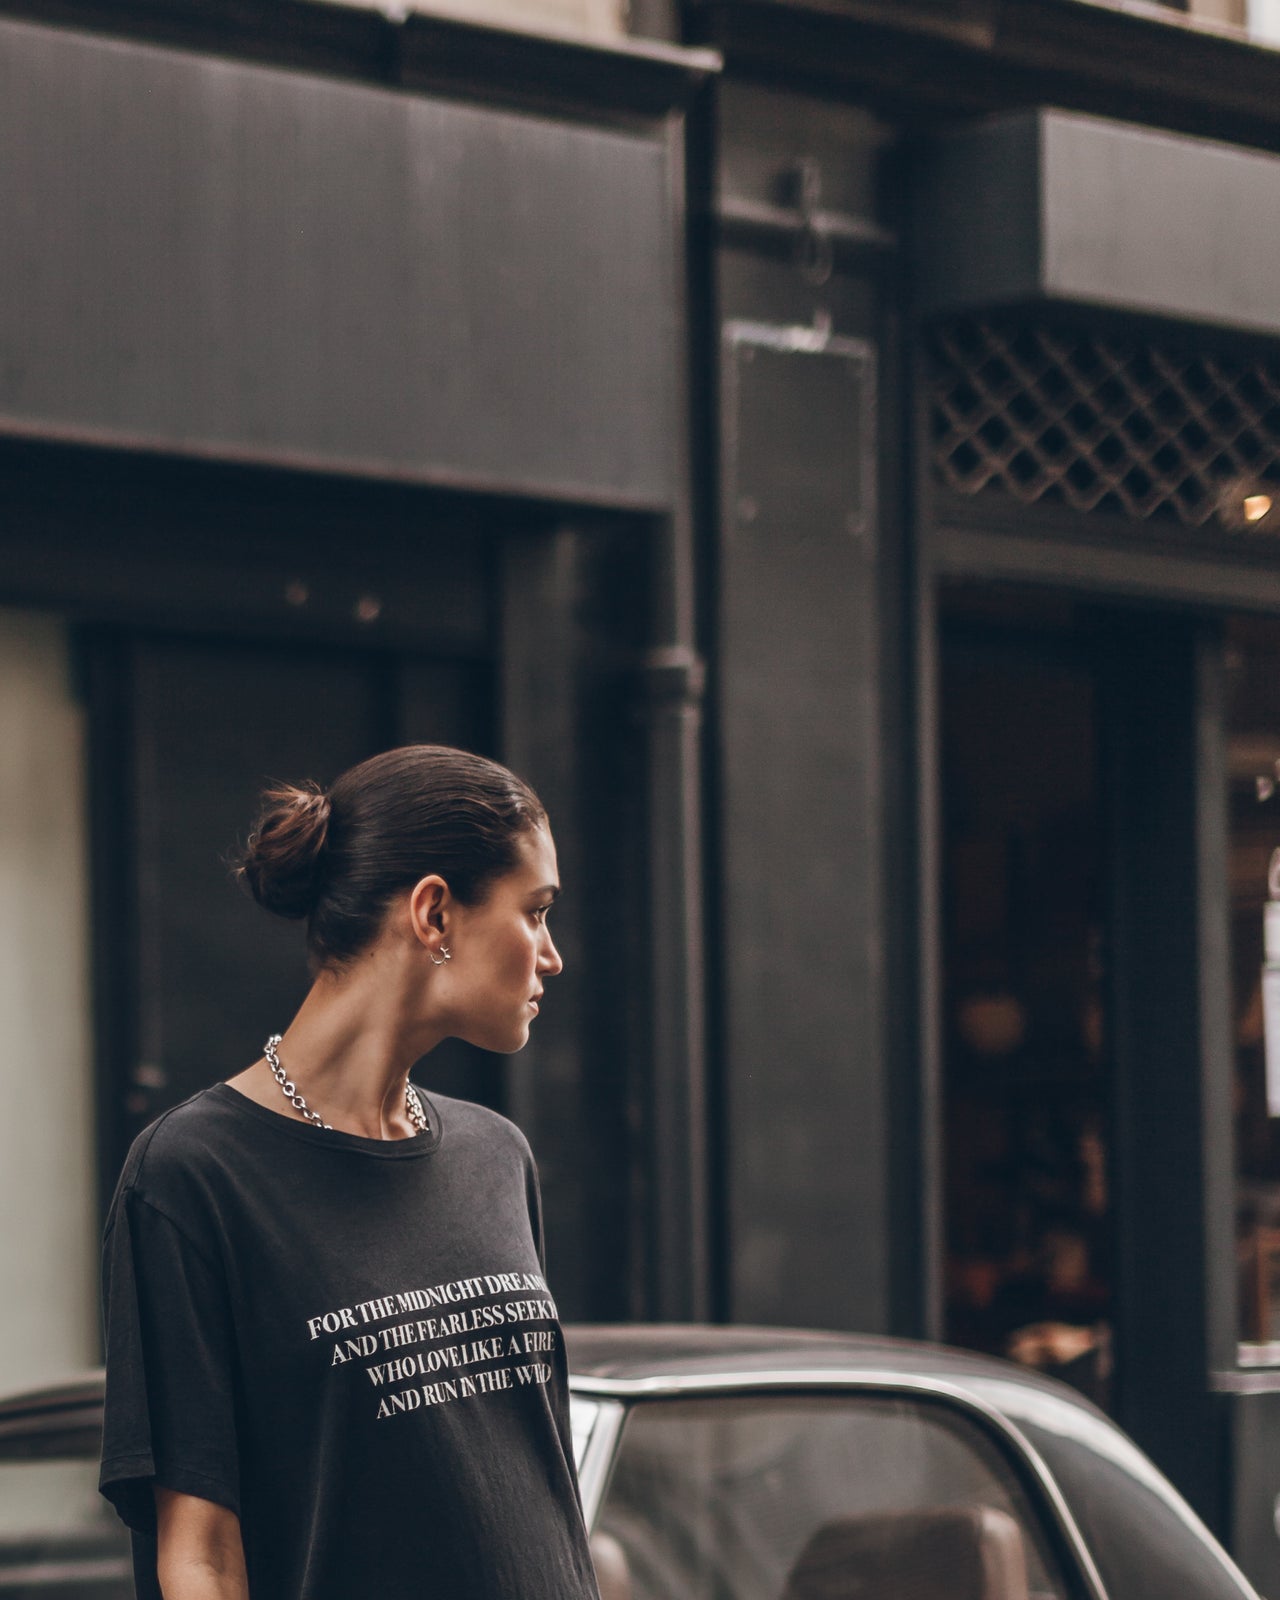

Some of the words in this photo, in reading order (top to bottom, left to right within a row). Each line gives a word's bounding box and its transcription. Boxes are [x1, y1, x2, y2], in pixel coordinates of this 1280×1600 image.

[307, 1308, 358, 1340] FOR
[355, 1295, 399, 1323] THE
[396, 1276, 485, 1313] MIDNIGHT
[331, 1334, 378, 1366] AND
[378, 1323, 418, 1350] THE
[415, 1305, 505, 1341] FEARLESS
[366, 1356, 416, 1387] WHO
[416, 1346, 462, 1374] LOVE
[459, 1337, 504, 1365] LIKE
[507, 1335, 521, 1355] A
[523, 1331, 556, 1353] FIRE
[376, 1389, 421, 1419] AND
[421, 1379, 459, 1406] RUN
[459, 1374, 477, 1398] IN
[475, 1367, 514, 1393] THE
